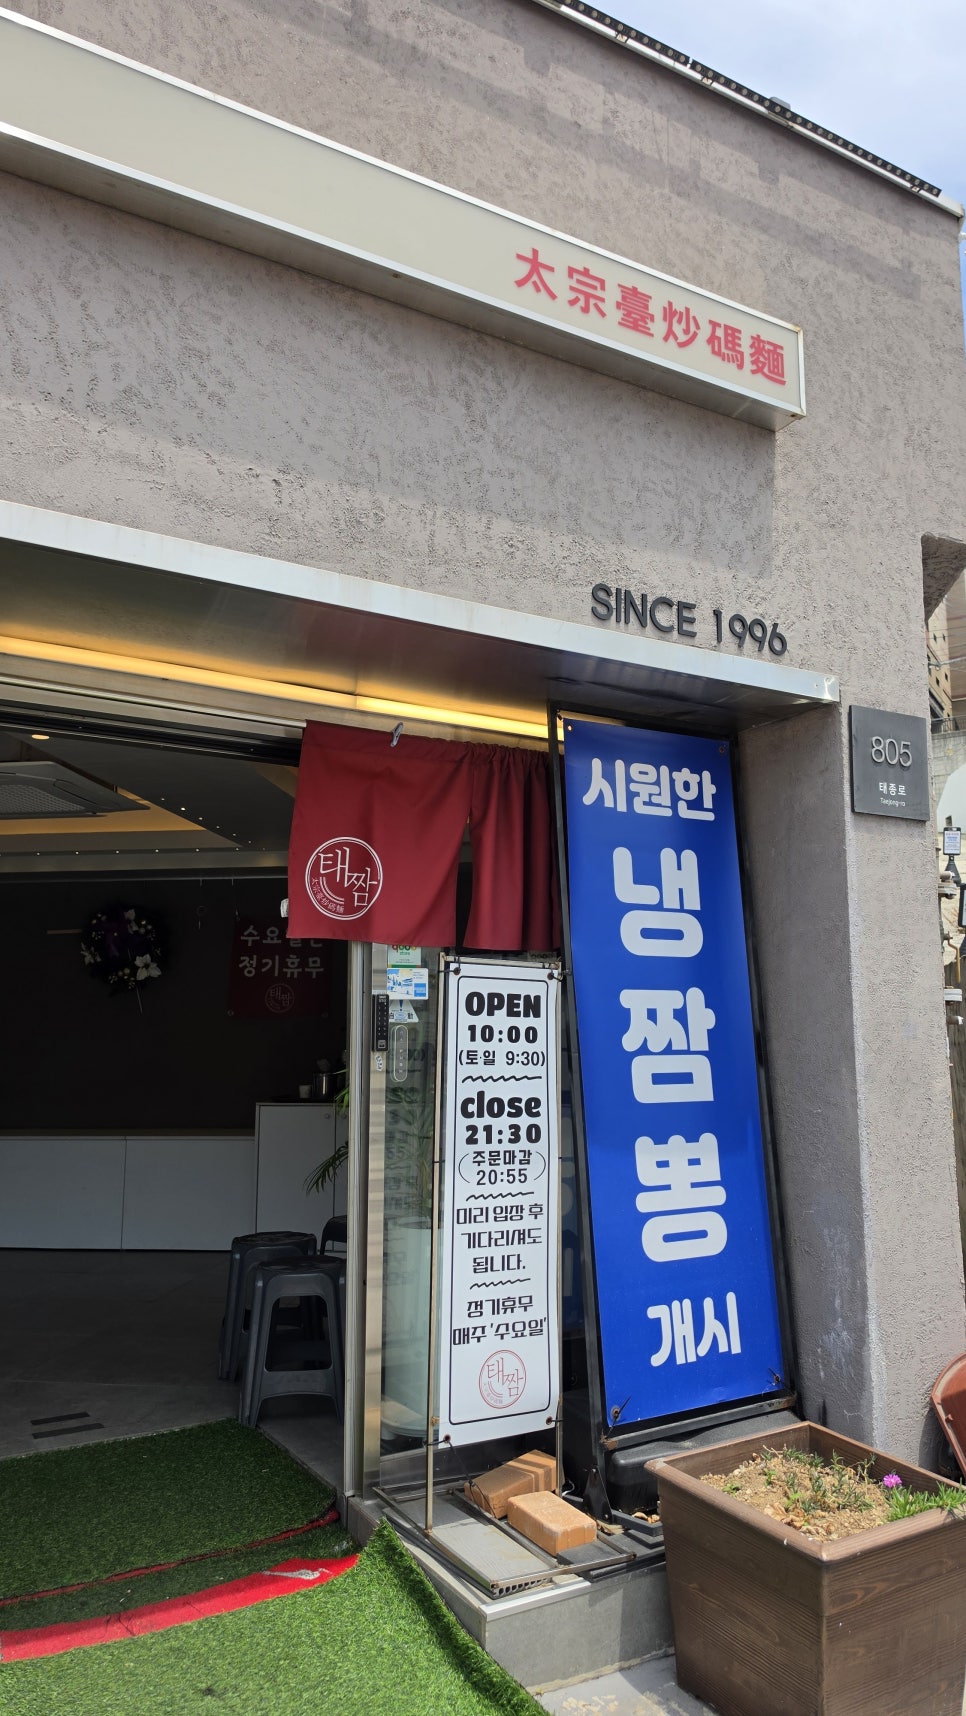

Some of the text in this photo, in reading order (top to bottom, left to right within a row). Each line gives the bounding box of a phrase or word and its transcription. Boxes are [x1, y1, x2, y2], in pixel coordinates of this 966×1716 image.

[514, 247, 786, 386] 太宗臺炒碼麵
[591, 583, 788, 656] SINCE 1996
[871, 736, 912, 767] 805
[582, 757, 717, 821] 시원한
[879, 782, 906, 796] 태종로
[880, 797, 906, 808] Taejong-ro
[318, 846, 378, 907] 태짬
[238, 954, 324, 979] 정기휴무
[465, 992, 541, 1018] OPEN
[468, 1025, 538, 1044] 10:00
[505, 1050, 546, 1067] 9:30)
[613, 846, 727, 1263] 냉짬뽕
[460, 1091, 542, 1119] close
[465, 1123, 542, 1145] 21:30
[472, 1150, 532, 1167] 주문마감
[476, 1168, 528, 1185] 20:55
[456, 1202, 544, 1226] 미리 입장 후
[460, 1228, 543, 1250] 기다리셔도
[472, 1253, 526, 1274] 됩니다.
[467, 1295, 534, 1318] 정기휴무
[453, 1316, 547, 1346] 매주 '수요일'
[647, 1291, 741, 1366] 개시
[486, 1357, 524, 1397] 태짬
